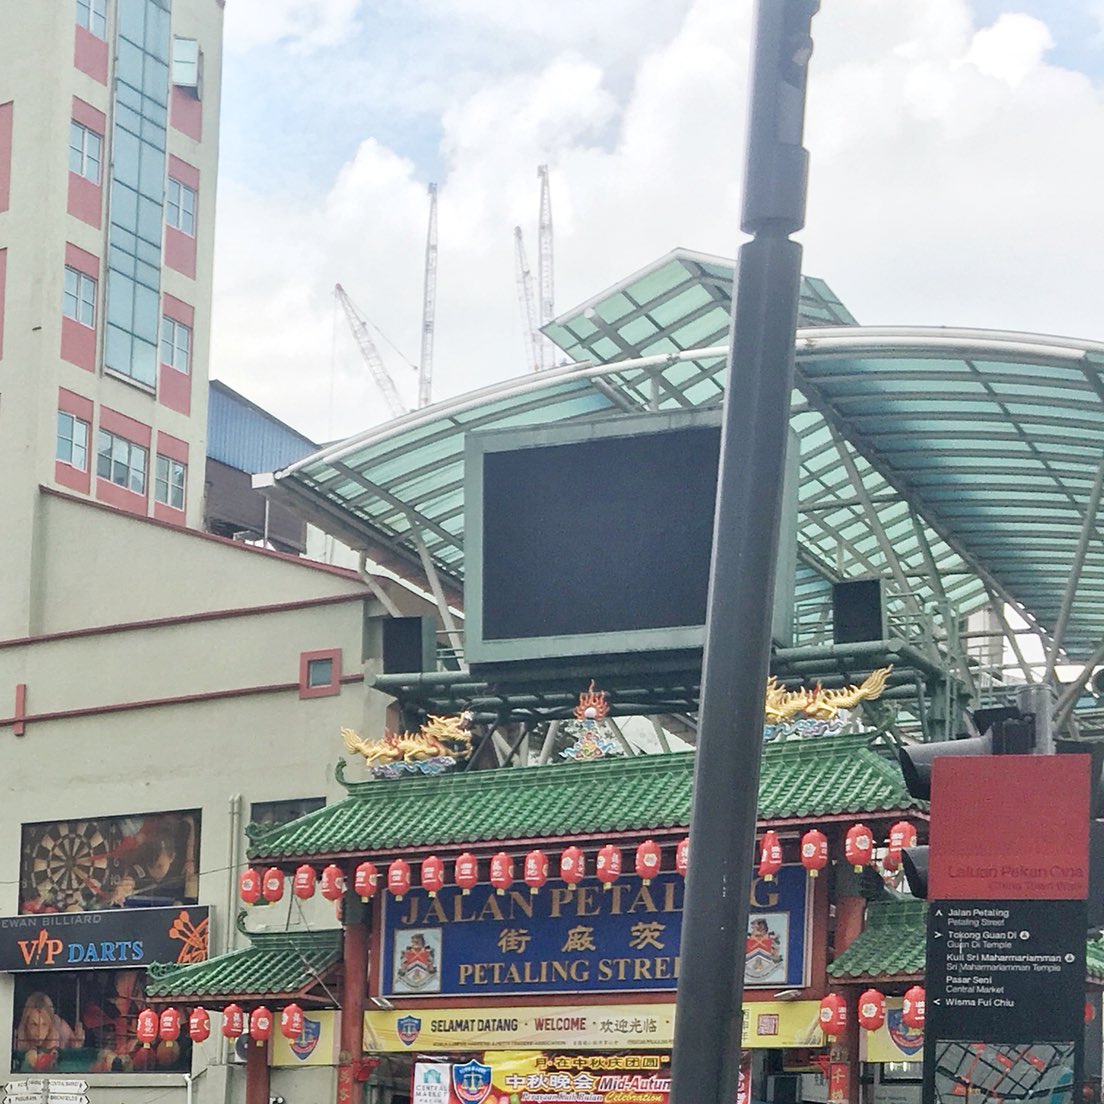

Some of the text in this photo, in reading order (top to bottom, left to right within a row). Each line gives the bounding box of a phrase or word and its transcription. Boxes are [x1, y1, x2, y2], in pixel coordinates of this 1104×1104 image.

[401, 889, 534, 925] JALAN
[948, 908, 1010, 919] Jalan Petaling
[42, 914, 102, 926] BILLIARD
[947, 918, 1005, 928] Petaling Street
[948, 930, 1018, 940] Tokong Guan Di
[947, 941, 1012, 950] Guan Di Temple
[67, 940, 144, 964] DARTS
[946, 953, 965, 962] Kuil
[966, 953, 980, 962] Sri
[458, 958, 589, 986] PETALING
[946, 963, 958, 971] Sri
[1033, 963, 1062, 973] Temple
[946, 975, 993, 984] Pasar Seni
[946, 985, 1004, 994] Central Market
[945, 998, 976, 1006] Wisma
[993, 998, 1015, 1008] Chiu
[431, 1016, 587, 1033] SELAMAT DATANG WELCOME
[599, 1018, 658, 1034] 欢迎光临
[504, 1073, 595, 1091] 中秋晚会
[604, 1091, 663, 1103] Celebration
